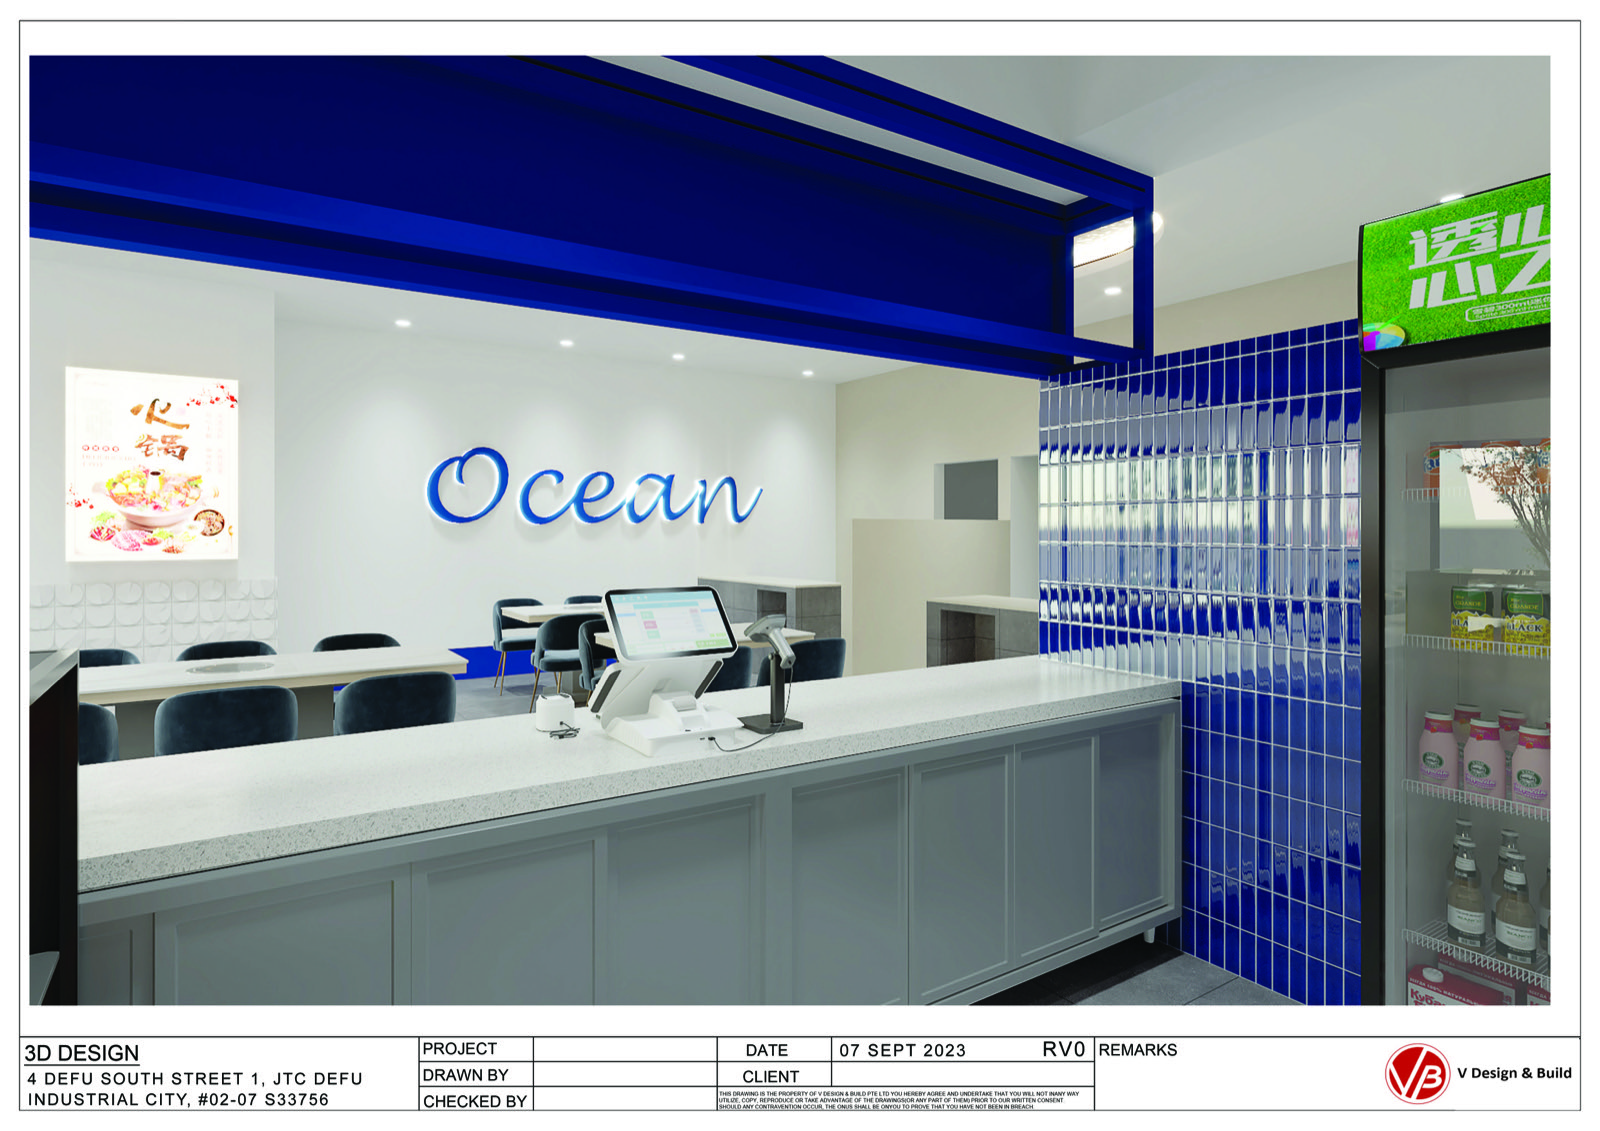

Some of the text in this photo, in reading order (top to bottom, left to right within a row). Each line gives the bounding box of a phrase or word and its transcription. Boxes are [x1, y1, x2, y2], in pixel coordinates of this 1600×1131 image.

[130, 398, 190, 461] 火锅
[426, 446, 763, 524] Ocean
[1452, 618, 1469, 627] BLA
[24, 1044, 139, 1062] 3D DESIGN
[423, 1042, 497, 1056] PROJECT
[746, 1043, 788, 1057] DATE
[839, 1043, 966, 1058] 07 SEPT 2023
[1099, 1043, 1177, 1057] REMARKS
[27, 1071, 362, 1088] 4 DEFU SOUTH STREET 1, JTC DEFU
[423, 1068, 510, 1082] DRAWN BY
[743, 1069, 800, 1084] CLIENT
[1457, 1067, 1572, 1082] V Design & Build
[28, 1092, 329, 1109] INDUSTRIAL CITY, #02-07 S33756
[423, 1094, 530, 1108] CHECKED BY
